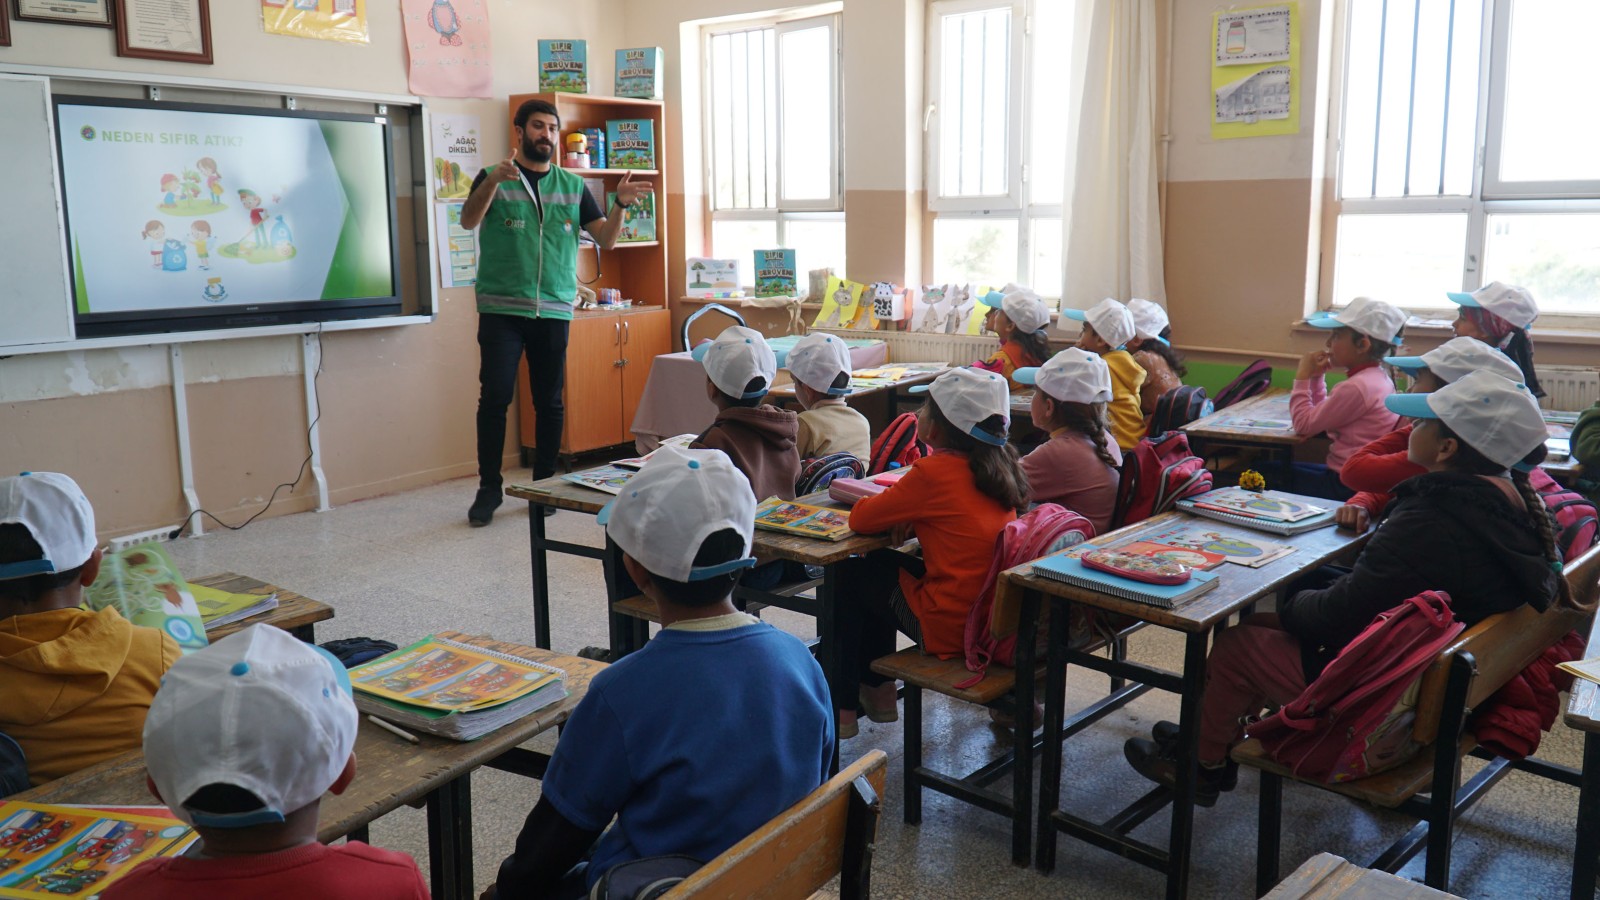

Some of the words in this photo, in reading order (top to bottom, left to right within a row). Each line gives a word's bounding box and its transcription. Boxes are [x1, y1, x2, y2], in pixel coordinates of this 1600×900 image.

[101, 130, 154, 144] NEDEN
[159, 132, 200, 145] SIFIR
[204, 134, 244, 147] ATIK?
[455, 136, 477, 147] AĞAÇ
[448, 144, 477, 154] DİKELİM
